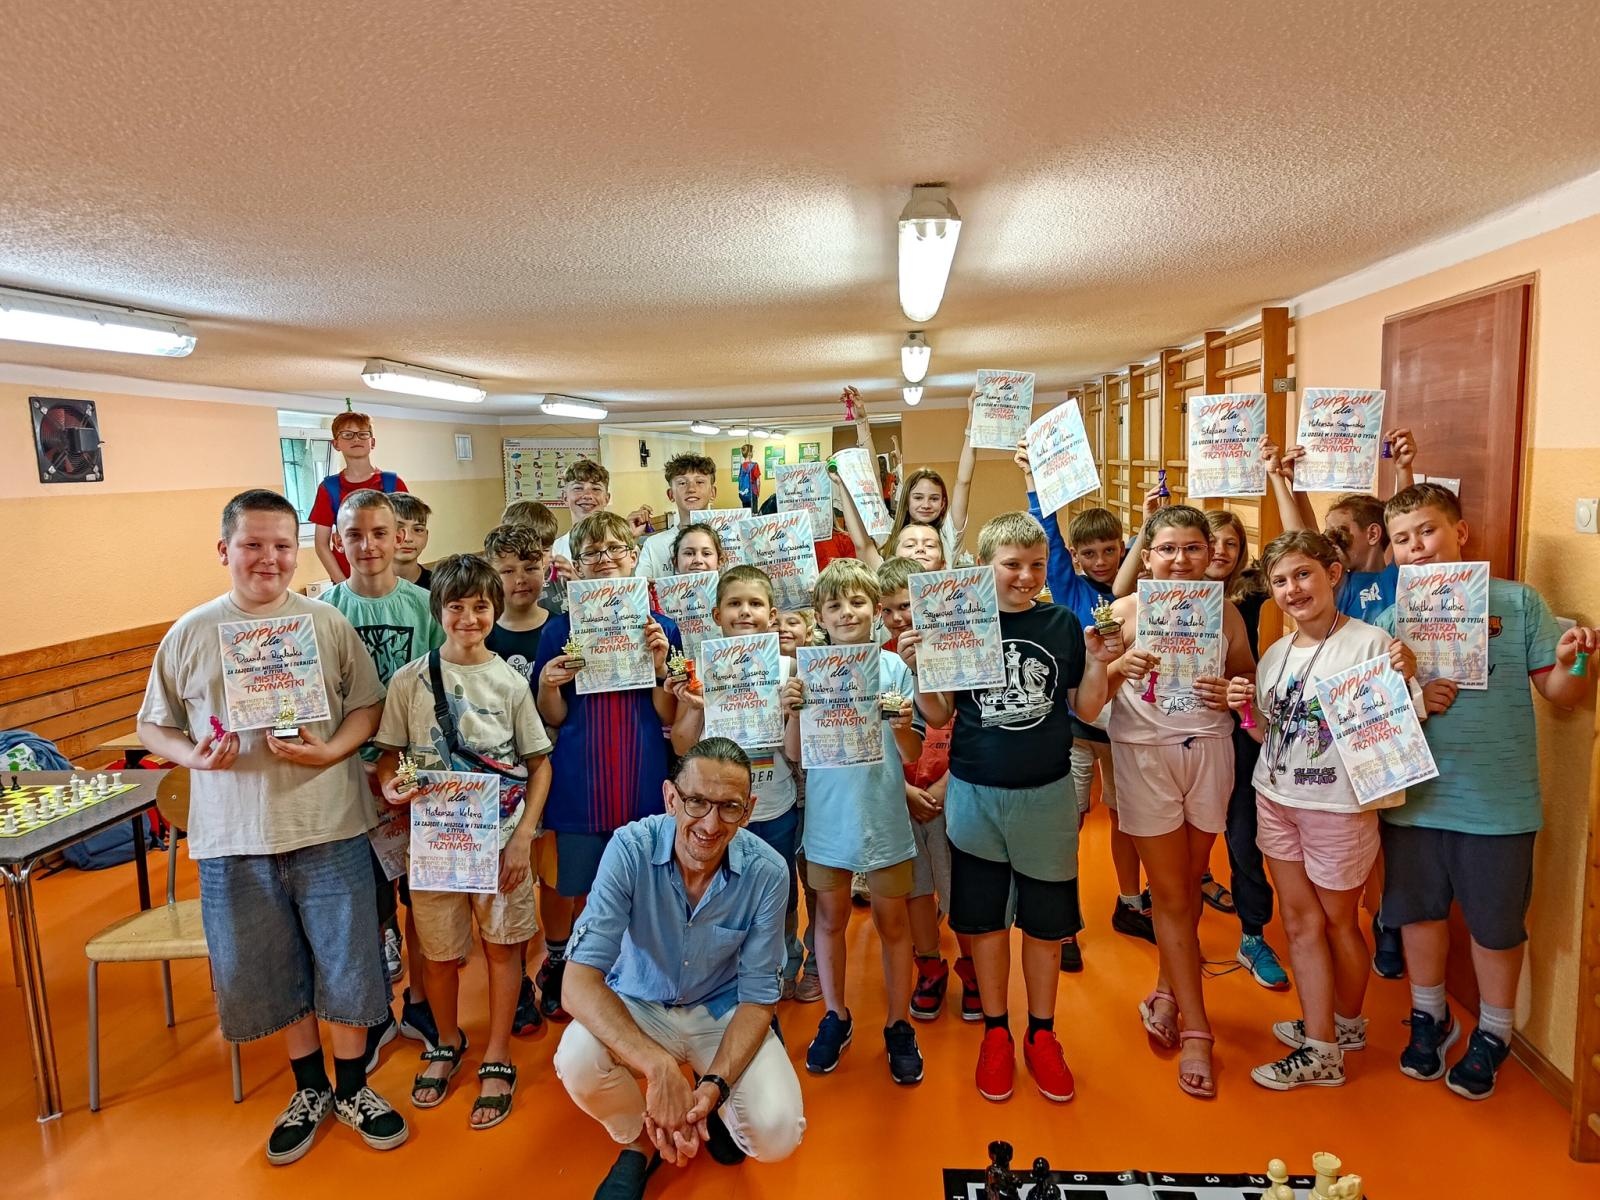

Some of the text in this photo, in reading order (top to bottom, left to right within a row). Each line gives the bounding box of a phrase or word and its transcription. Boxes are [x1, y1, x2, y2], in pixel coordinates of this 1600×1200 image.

[983, 377, 1025, 386] DYPLOM
[1312, 395, 1373, 409] DYPLOM
[1200, 399, 1255, 417] DYPLOM
[1333, 406, 1354, 414] dla
[984, 412, 1020, 420] TRZYNASTKI
[1221, 411, 1239, 420] dla
[1031, 408, 1068, 446] DYPLOM
[1047, 426, 1057, 439] dla
[1212, 443, 1243, 451] MISTRZA
[1312, 445, 1361, 453] TRZYNASTKI
[1203, 451, 1251, 459] TRZYNASTKI
[1043, 455, 1077, 478] TRZYNASTKI
[782, 467, 821, 482] DYPLOM
[798, 476, 810, 484] dla
[718, 523, 730, 531] dla
[749, 517, 799, 540] DYPLOM
[770, 531, 787, 541] dla
[767, 562, 795, 572] MISTRZA
[1407, 570, 1472, 590] DYPLOM
[661, 576, 708, 599] DYPLOM
[920, 574, 981, 598] DYPLOM
[1432, 584, 1453, 595] dla
[580, 583, 636, 604] DYPLOM
[681, 590, 696, 600] dla
[945, 589, 967, 601] dla
[1147, 588, 1211, 604] DYPLOM
[603, 597, 622, 607] dla
[1172, 600, 1192, 610] dla
[232, 621, 299, 645] DYPLOM
[940, 631, 975, 640] MISTRZA
[1412, 632, 1467, 641] TRZYNASTKI
[261, 636, 283, 647] dla
[597, 635, 630, 645] MISTRZA
[932, 639, 984, 651] TRZYNASTKI
[1160, 637, 1196, 645] MISTRZA
[589, 643, 638, 654] TRZYNASTKI
[711, 640, 766, 663] DYPLOM
[1152, 645, 1205, 655] TRZYNASTKI
[733, 654, 752, 665] dla
[807, 651, 867, 672] DYPLOM
[830, 666, 851, 677] dla
[254, 672, 293, 684] MISTRZA
[1329, 662, 1384, 704] DYPLOM
[245, 679, 304, 693] TRZYNASTKI
[726, 692, 758, 702] MISTRZA
[1353, 685, 1370, 701] dla
[720, 700, 767, 711] TRZYNASTKI
[823, 708, 858, 718] MISTRZA
[816, 716, 867, 727] TRZYNASTKI
[1365, 714, 1389, 728] TURNIEJU
[1357, 720, 1390, 739] MISTRZA
[1353, 726, 1402, 752] TRZYNASTKI
[1294, 775, 1337, 785] AFRAID
[421, 780, 486, 796] DYPLOM
[448, 792, 469, 802] dla
[437, 833, 472, 842] MISTRZA
[428, 841, 481, 851] TRZYNASTKI
[1118, 1173, 1132, 1181] 5
[1250, 1176, 1264, 1184] 2
